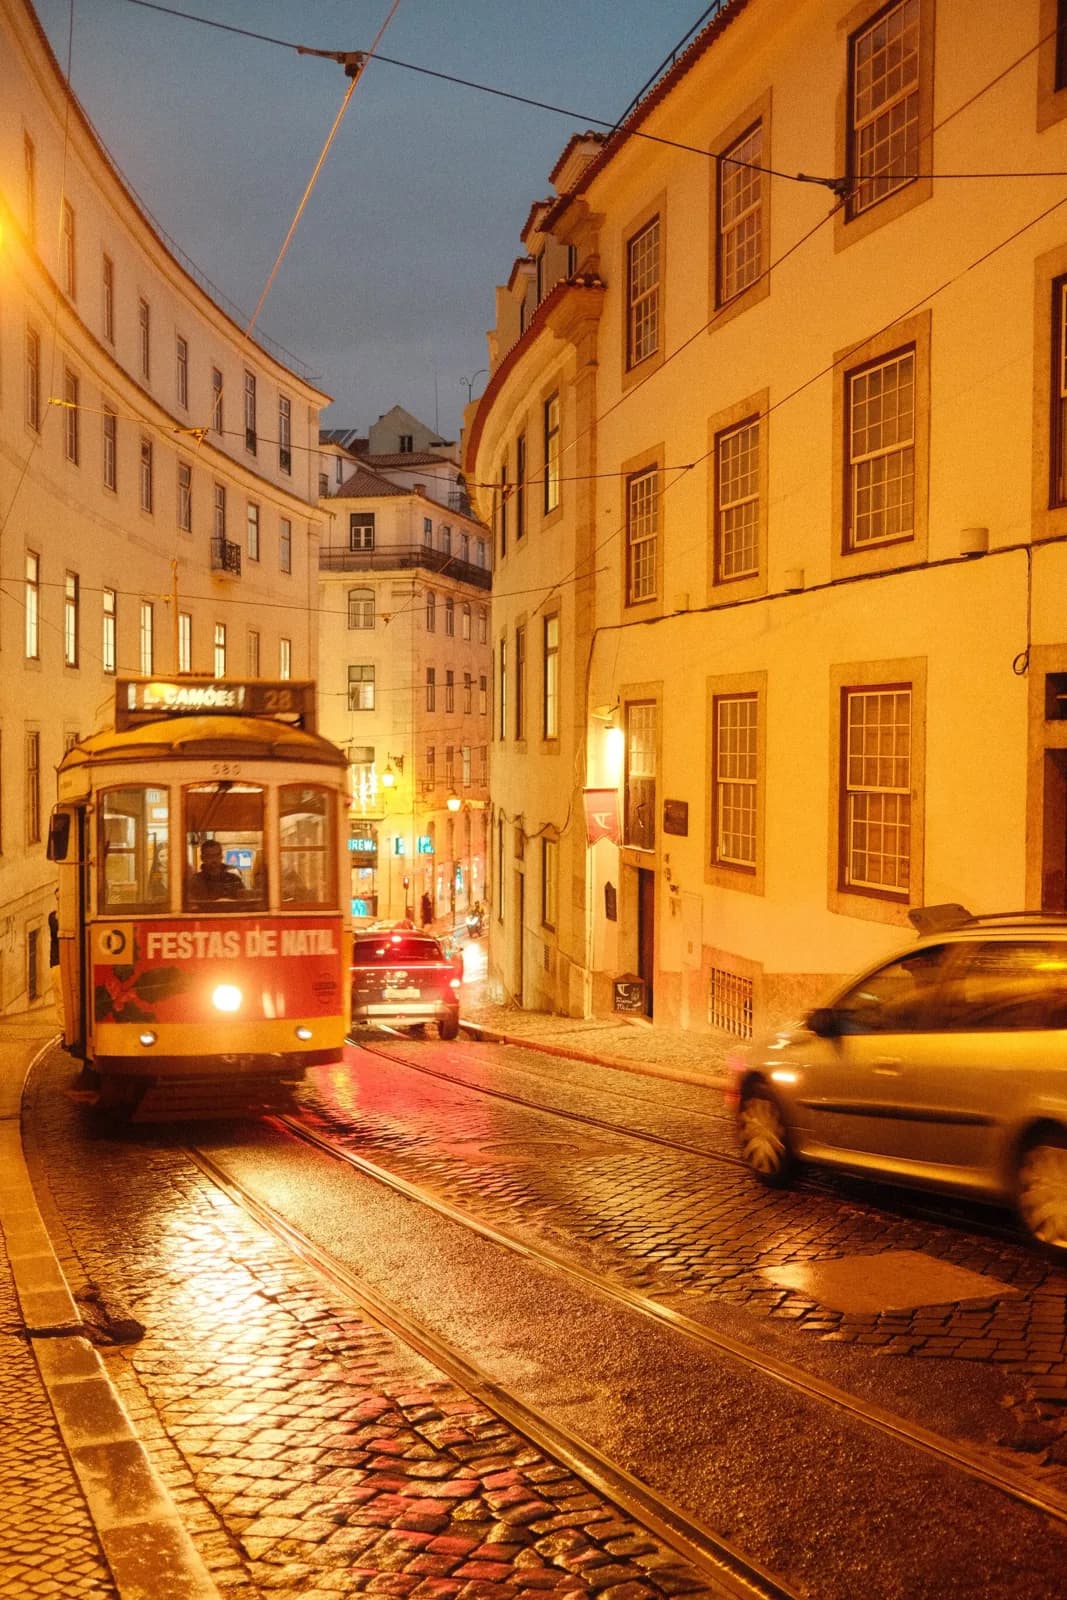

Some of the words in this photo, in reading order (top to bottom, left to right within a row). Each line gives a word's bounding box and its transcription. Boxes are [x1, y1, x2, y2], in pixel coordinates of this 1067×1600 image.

[264, 690, 292, 710] 28
[147, 930, 240, 959] FESTAS
[245, 930, 278, 957] DE
